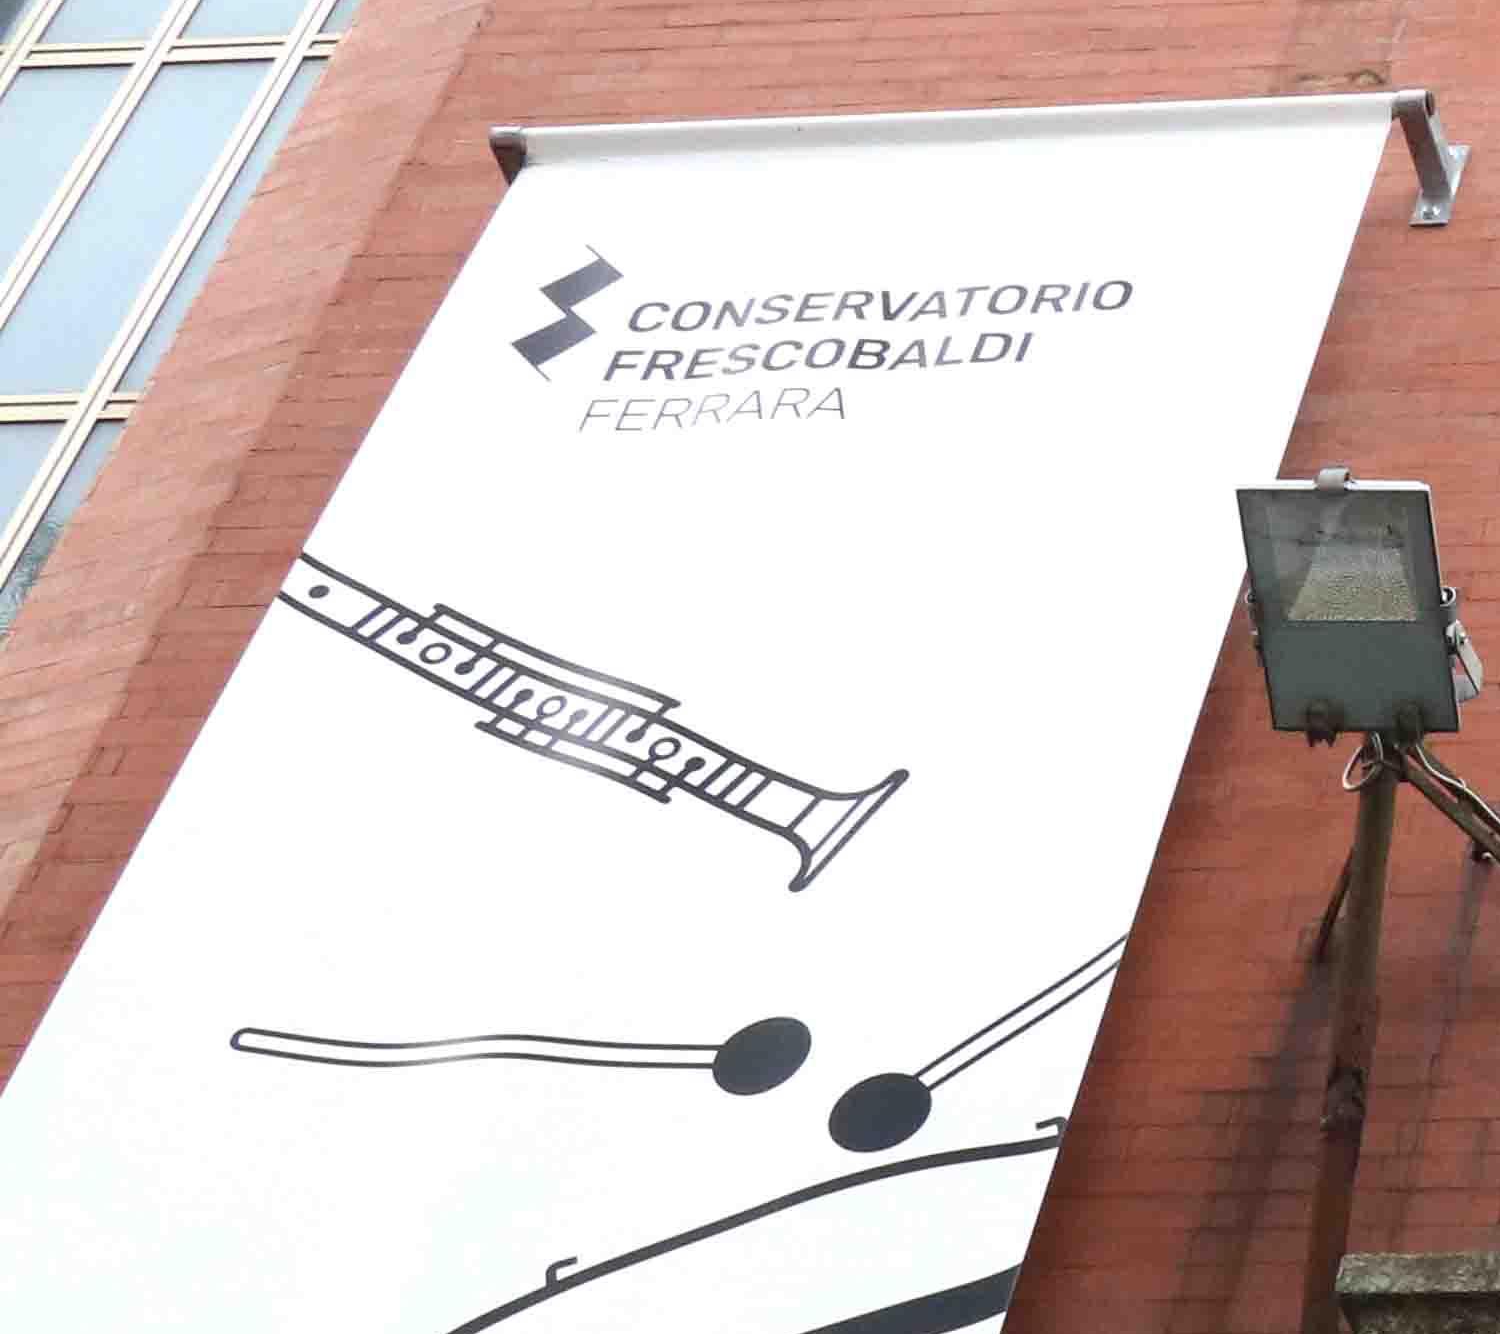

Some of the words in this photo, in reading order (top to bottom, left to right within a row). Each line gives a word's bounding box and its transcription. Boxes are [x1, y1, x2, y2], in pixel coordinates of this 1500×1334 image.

[626, 279, 1134, 333] CONSERVATORIO
[602, 331, 1036, 381] FRESCOBALDI
[578, 386, 848, 433] FERRARA
